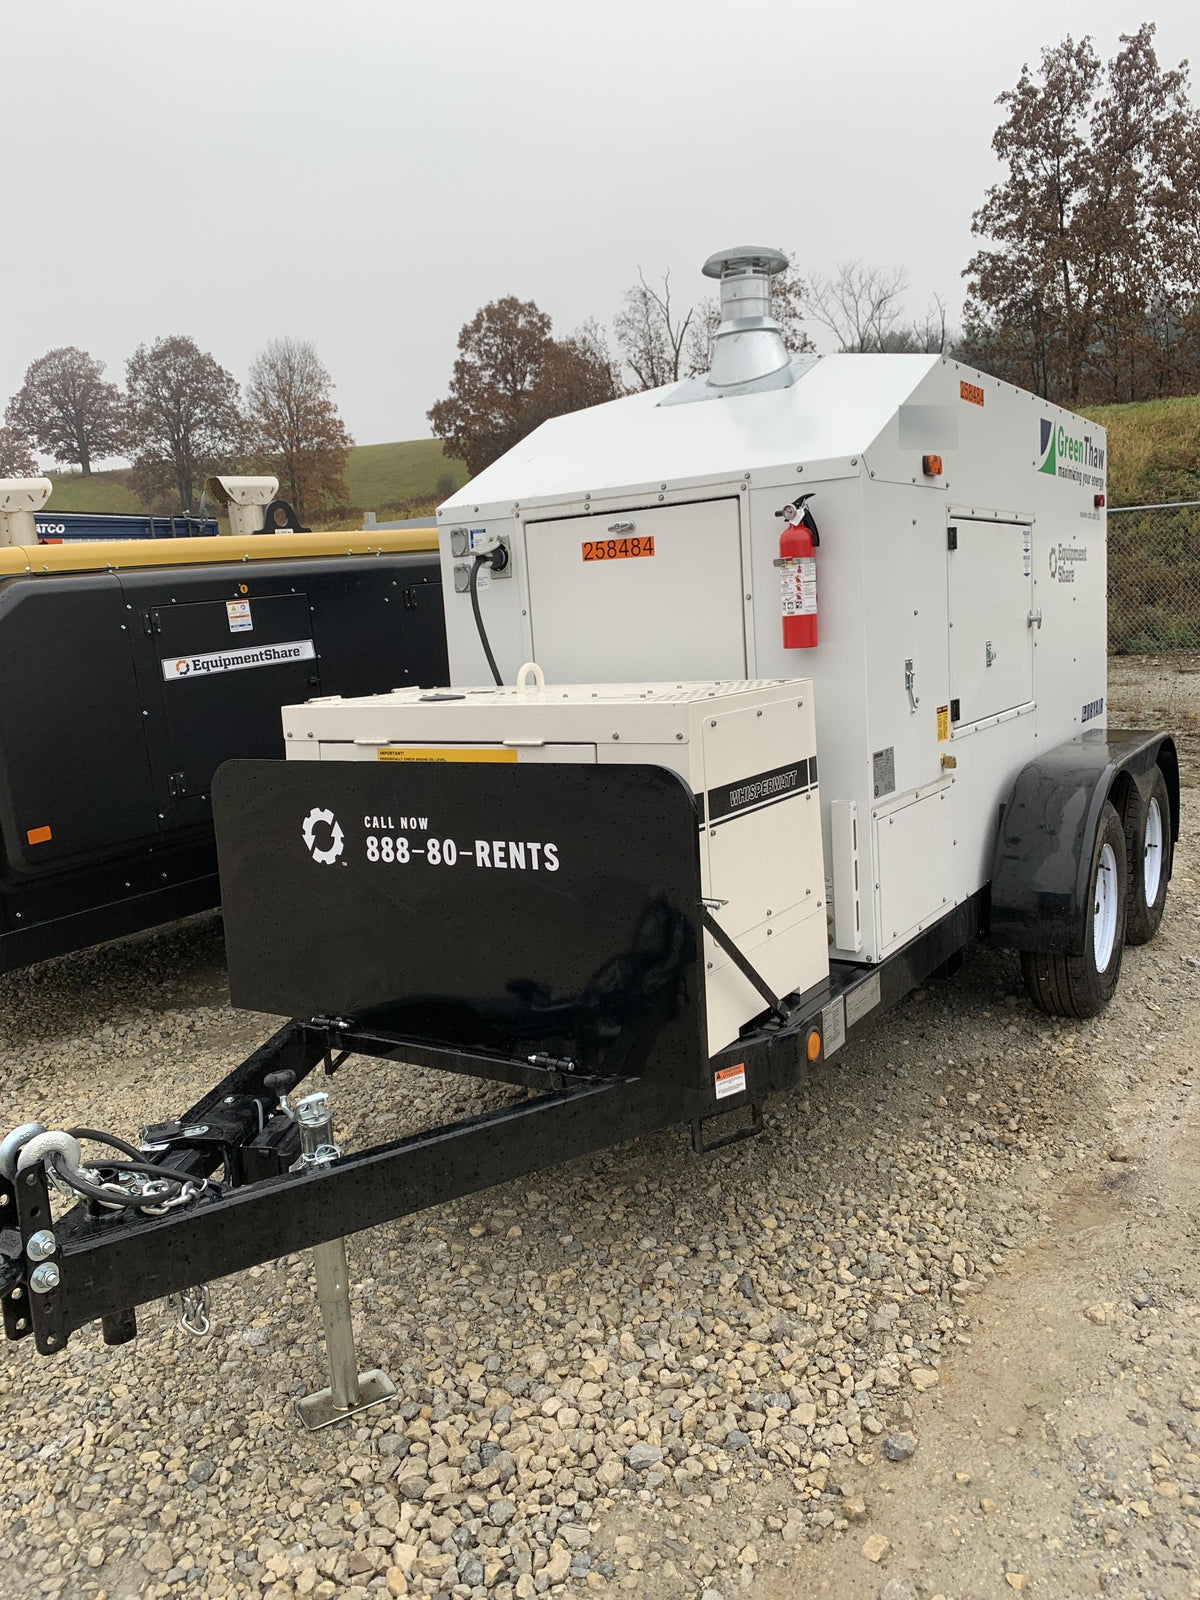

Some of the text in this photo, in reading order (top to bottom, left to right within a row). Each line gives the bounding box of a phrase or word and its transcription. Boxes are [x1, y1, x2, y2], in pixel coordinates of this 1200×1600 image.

[1058, 425, 1104, 470] GreenThaw
[583, 536, 654, 560] 258484
[1058, 543, 1087, 565] Equipment
[1058, 565, 1075, 583] Share
[192, 647, 300, 673] EquipmentShare
[729, 769, 798, 807] WHISPERWATT
[364, 815, 429, 830] CALL NOW
[366, 836, 560, 872] 888-80-RENTS
